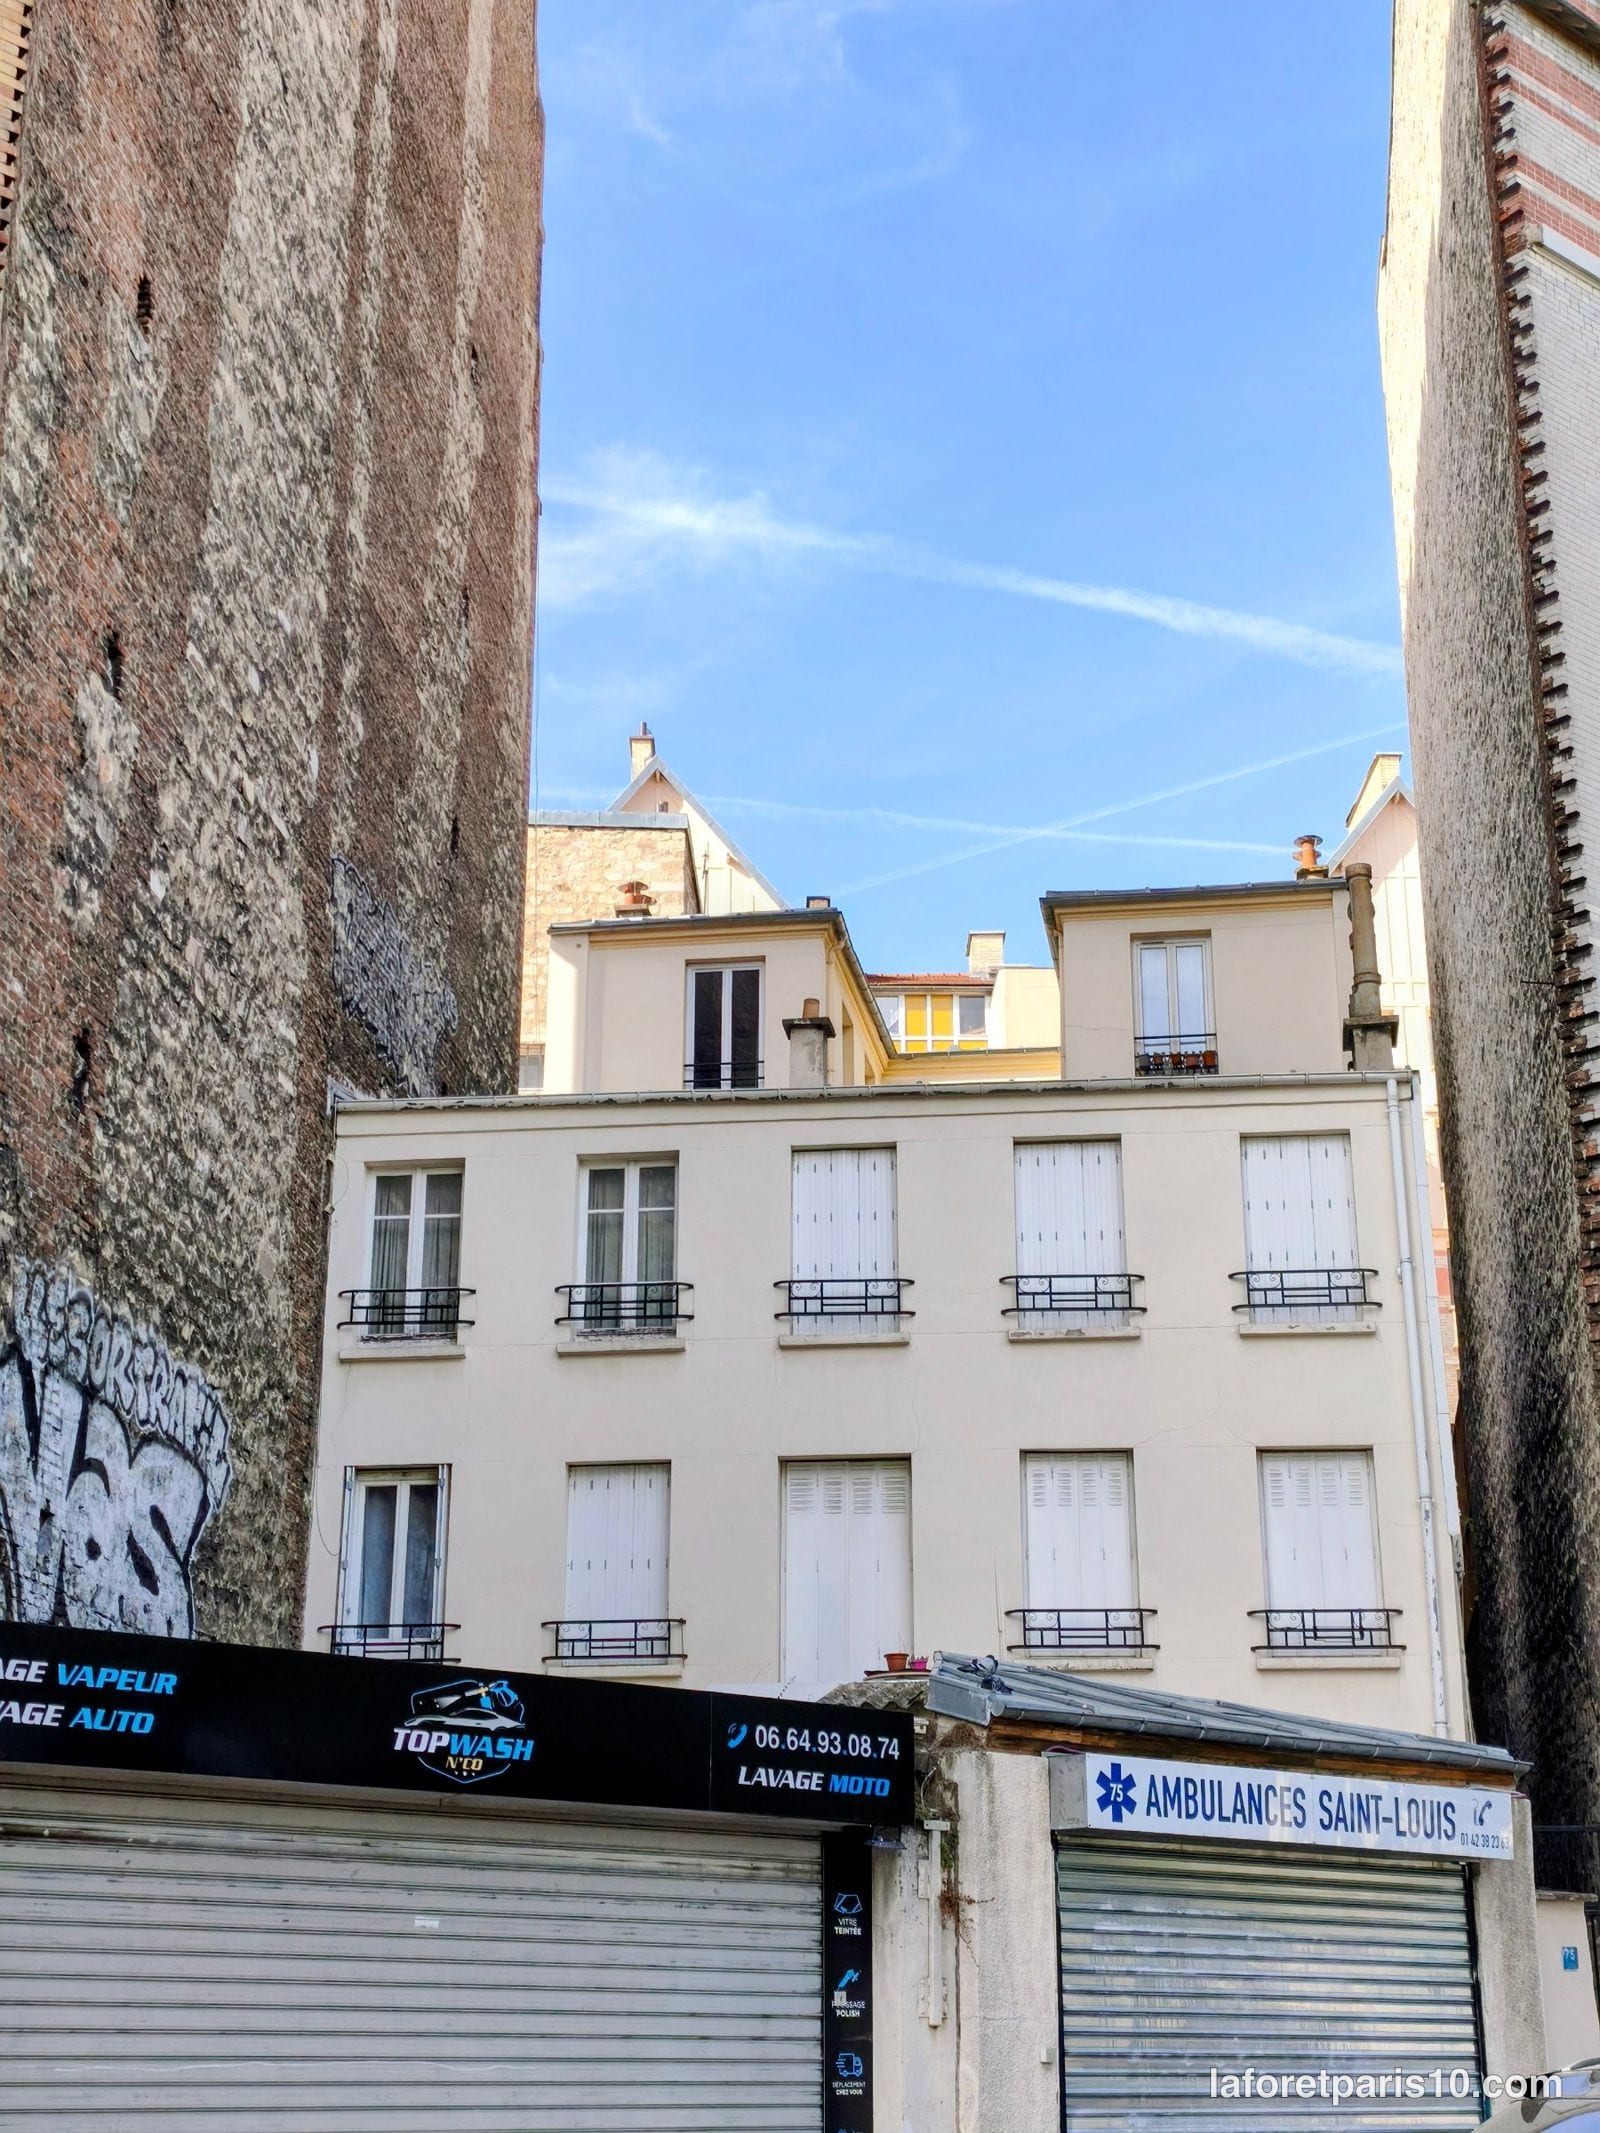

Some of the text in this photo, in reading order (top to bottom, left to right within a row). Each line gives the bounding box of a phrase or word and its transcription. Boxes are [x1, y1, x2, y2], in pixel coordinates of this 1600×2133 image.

[58, 1663, 178, 1695] VAPEUR
[69, 1707, 155, 1734] AUTO
[393, 1728, 535, 1761] TOPWASH
[755, 1724, 900, 1760] 06.64.93.08.74
[738, 1765, 891, 1797] LAVAGE MOTO
[1110, 1783, 1124, 1802] 75
[1146, 1774, 1457, 1842] AMBULANCES SAINT-LOUIS
[1460, 1832, 1469, 1846] 01
[1470, 1833, 1480, 1848] 42
[1490, 1835, 1500, 1849] 23
[838, 1917, 858, 1927] VITRE
[835, 2009, 861, 2018] POLISH
